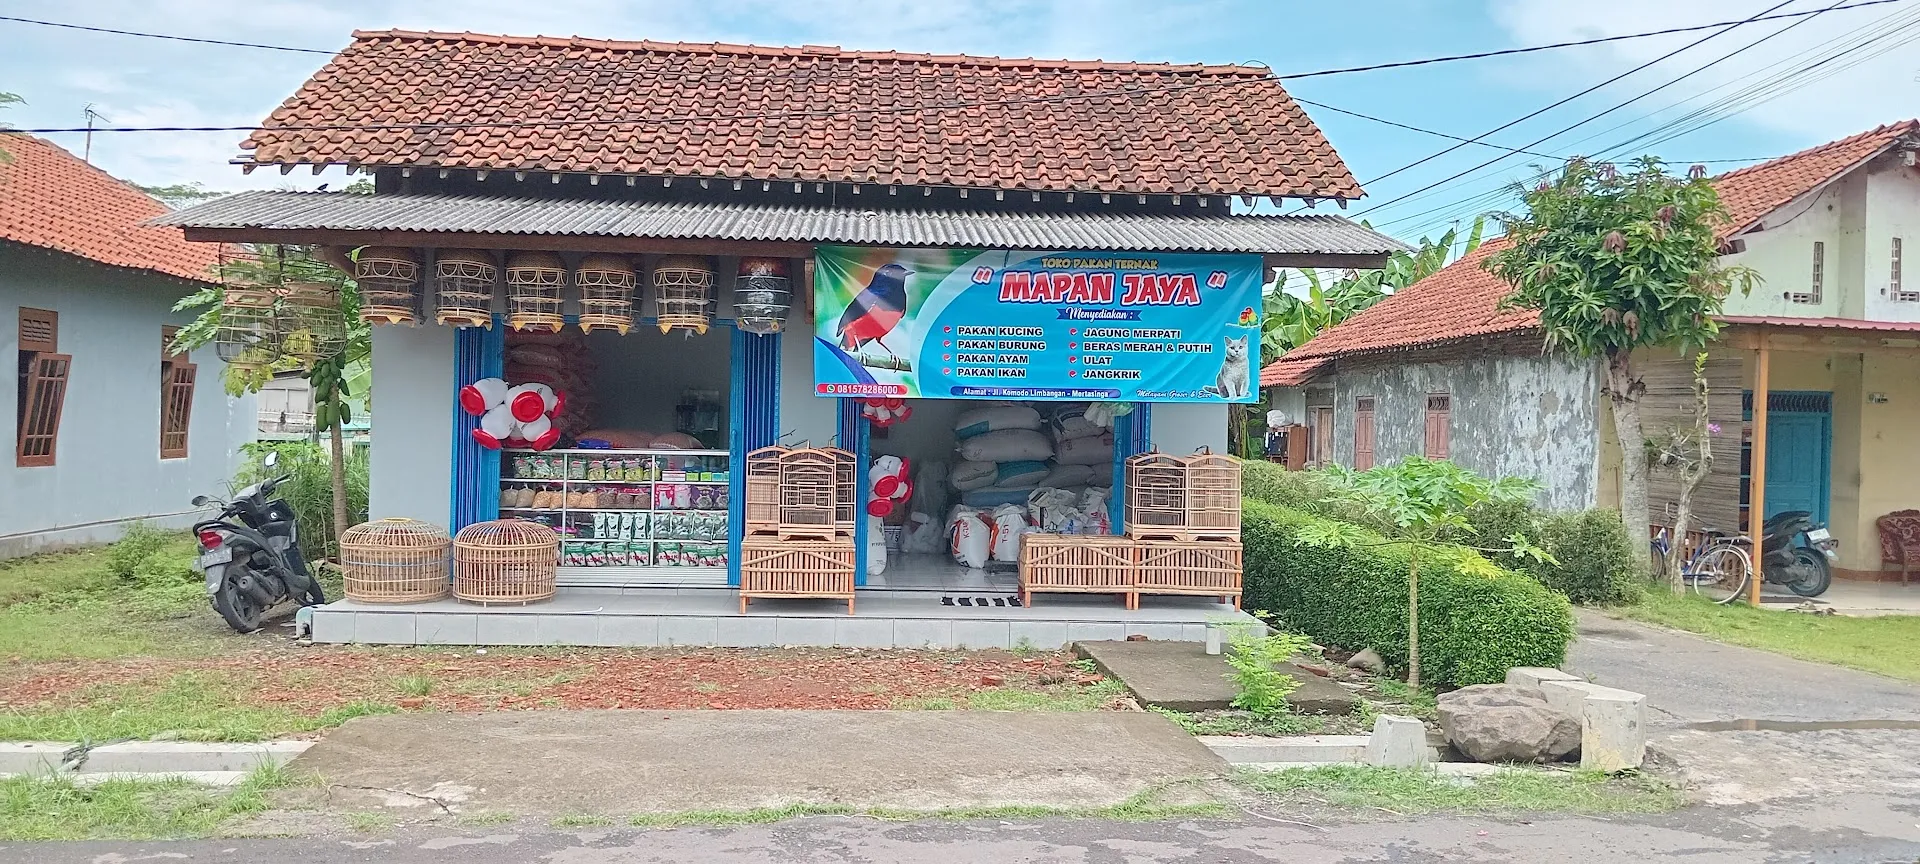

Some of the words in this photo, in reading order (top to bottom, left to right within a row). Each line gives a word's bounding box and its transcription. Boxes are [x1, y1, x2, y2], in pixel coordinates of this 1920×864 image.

[1041, 258, 1072, 269] TOKO
[1073, 258, 1113, 269] PAKAN
[1114, 259, 1158, 270] TERNAK
[1000, 272, 1114, 303] MAPAN
[1121, 272, 1200, 305] JAYA
[1065, 306, 1127, 322] Menyediakan
[957, 326, 996, 336] PAKAN
[999, 327, 1043, 336] KUCING
[1083, 328, 1130, 338] JAGUNG
[1133, 329, 1181, 339] MERPATI
[957, 340, 995, 350] PAKAN
[998, 341, 1046, 350] BURUNG
[1083, 343, 1120, 351] BERAS
[1123, 343, 1163, 352] MERAH
[1166, 344, 1174, 352] &
[1178, 344, 1212, 353] PUTIH
[957, 354, 995, 363] PAKAN
[998, 355, 1029, 364] AYAM
[1083, 356, 1112, 365] ULAT
[957, 368, 995, 377] PAKAN
[998, 369, 1026, 377] IKAN
[1083, 370, 1141, 379] JANGKRIK
[837, 385, 898, 394] 081578286000
[963, 388, 987, 396] Alamat
[1002, 389, 1029, 397] Komodo
[1030, 390, 1066, 398] Limbangan
[1071, 390, 1109, 399] Mertasinga
